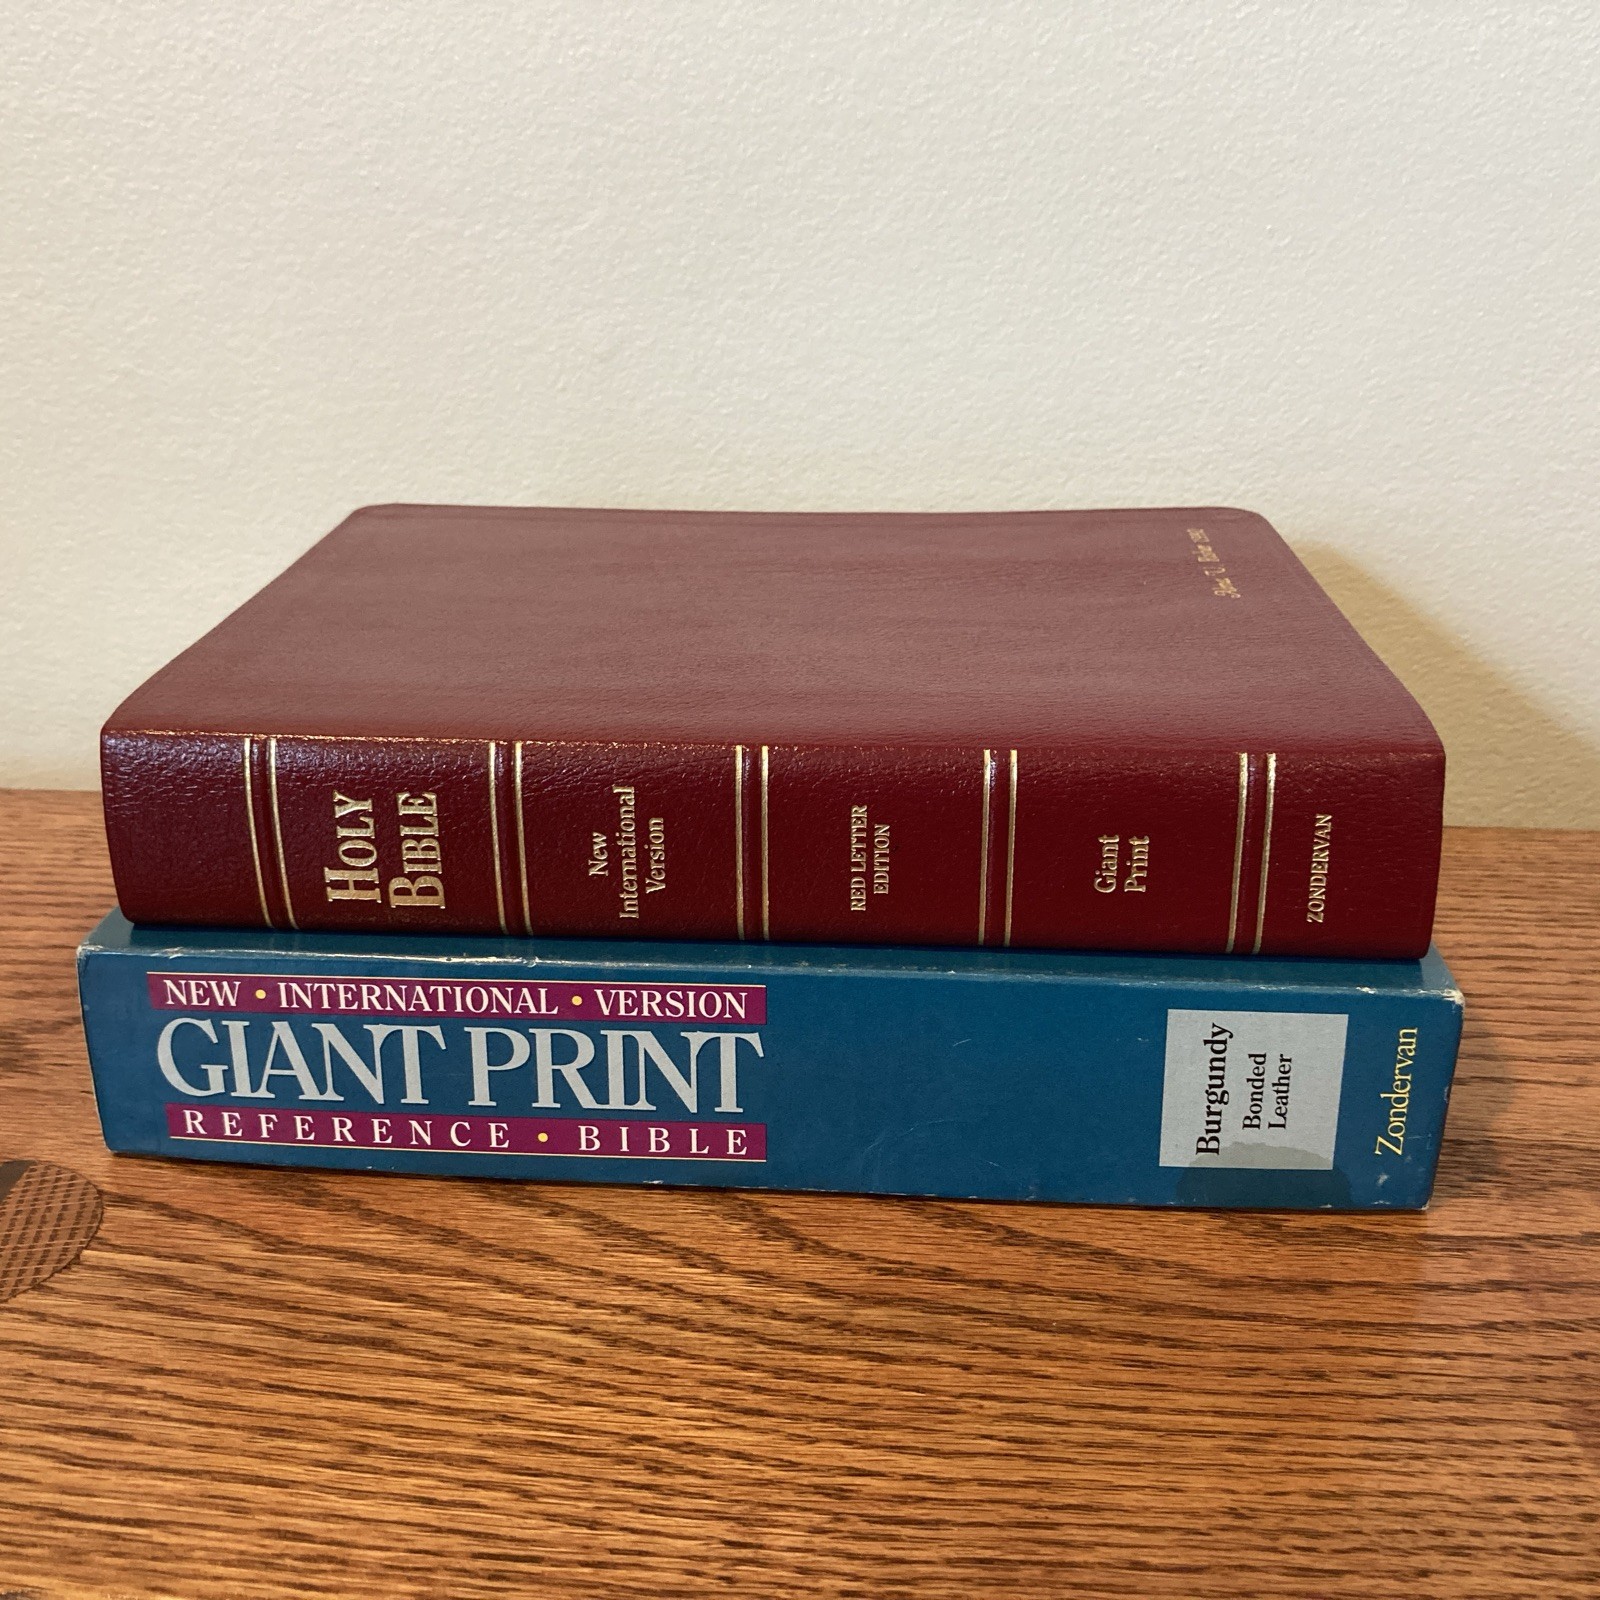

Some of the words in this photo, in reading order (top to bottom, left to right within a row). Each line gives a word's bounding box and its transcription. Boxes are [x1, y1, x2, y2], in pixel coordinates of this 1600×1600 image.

[324, 789, 382, 904] HOLY
[388, 791, 446, 910] BIBLE
[588, 831, 609, 877] New
[612, 785, 640, 919] International
[643, 817, 666, 894] Version
[850, 804, 868, 872] LETTER
[873, 823, 891, 895] EDITION
[1093, 834, 1120, 894] Giant
[1123, 835, 1150, 893] Print
[1306, 813, 1333, 923] ZONDERVAN
[850, 876, 867, 912] RED
[163, 979, 242, 1007] NEW
[277, 982, 559, 1016] INTERNATIONAL
[594, 988, 748, 1020] VERSION
[156, 1017, 447, 1105] GIANT
[463, 1026, 765, 1114] PRINT
[1195, 1022, 1235, 1156] Burgundy
[1242, 1052, 1268, 1131] Bonded
[1267, 1053, 1293, 1130] Leather
[1374, 1026, 1419, 1157] Zondervan
[182, 1109, 510, 1149] REFERENCE
[578, 1125, 748, 1156] BIBLE
